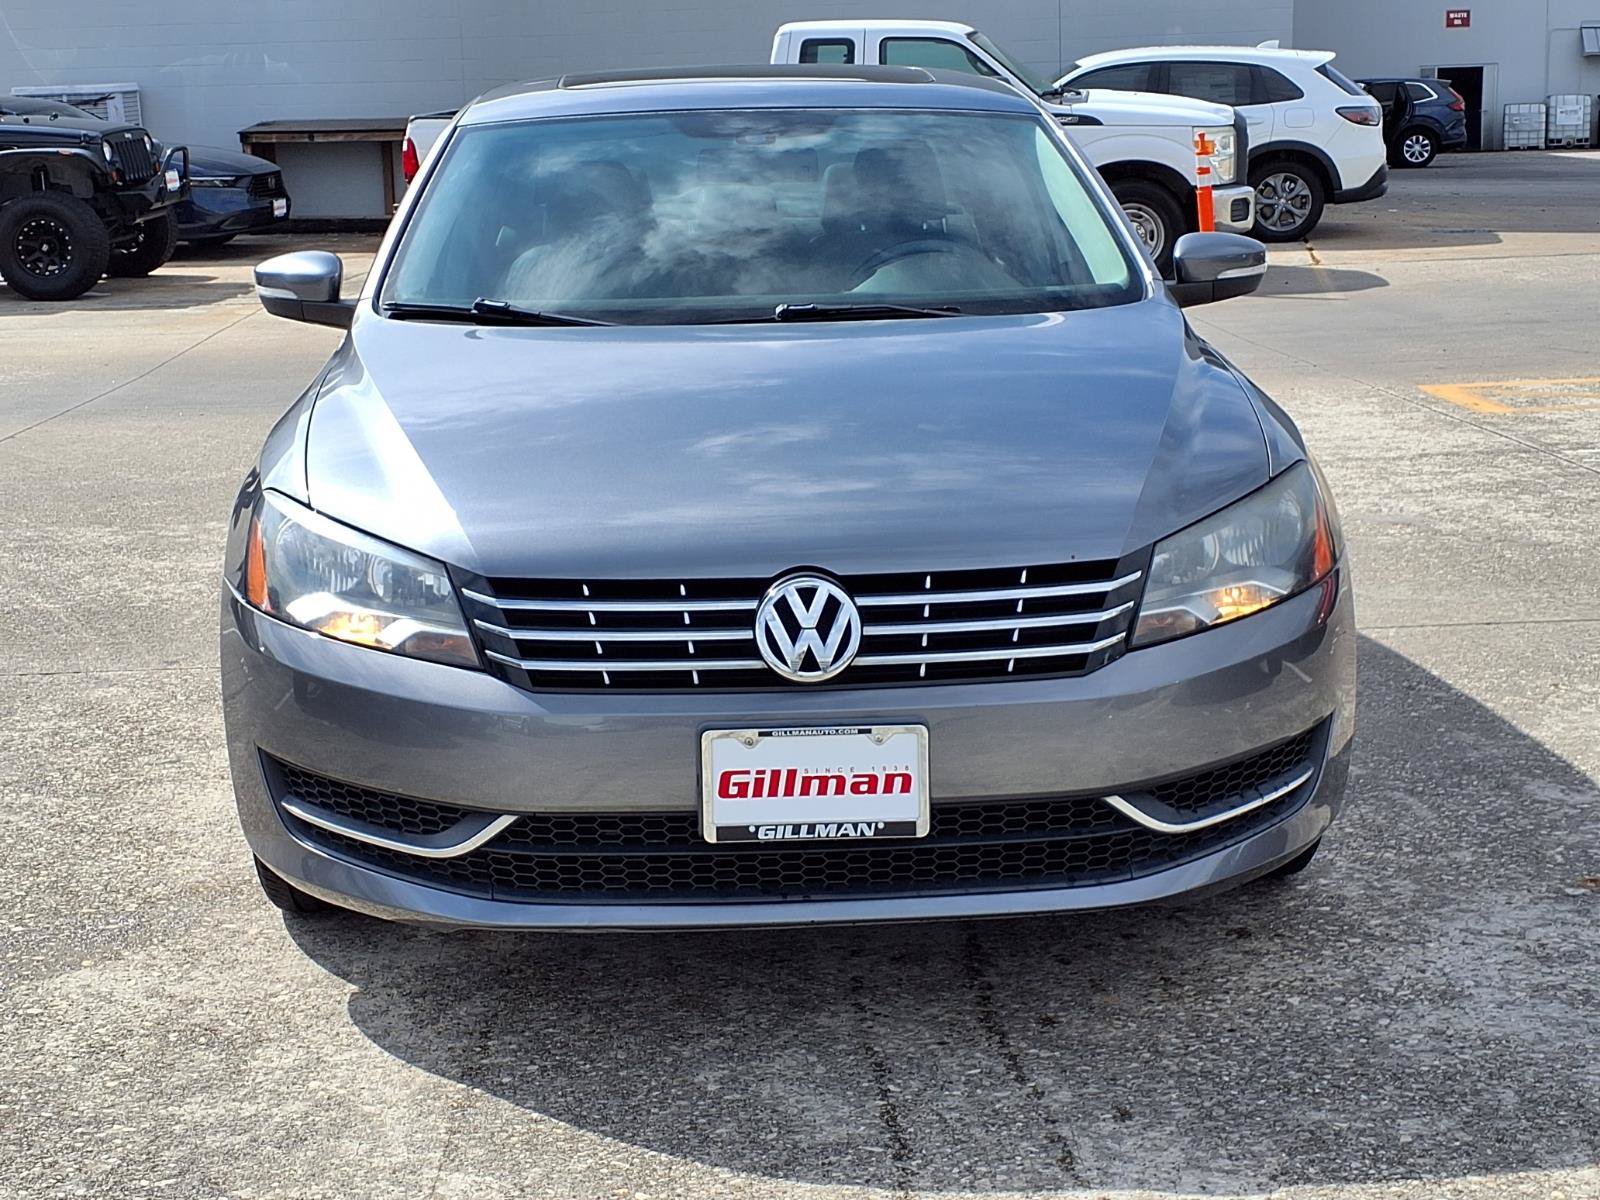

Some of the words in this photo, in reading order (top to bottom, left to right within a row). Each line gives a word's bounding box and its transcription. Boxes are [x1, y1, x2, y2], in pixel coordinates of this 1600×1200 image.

[771, 728, 859, 737] GILLMANAUTO.COM
[718, 768, 913, 799] Gillman
[757, 822, 876, 840] GILLMAN
